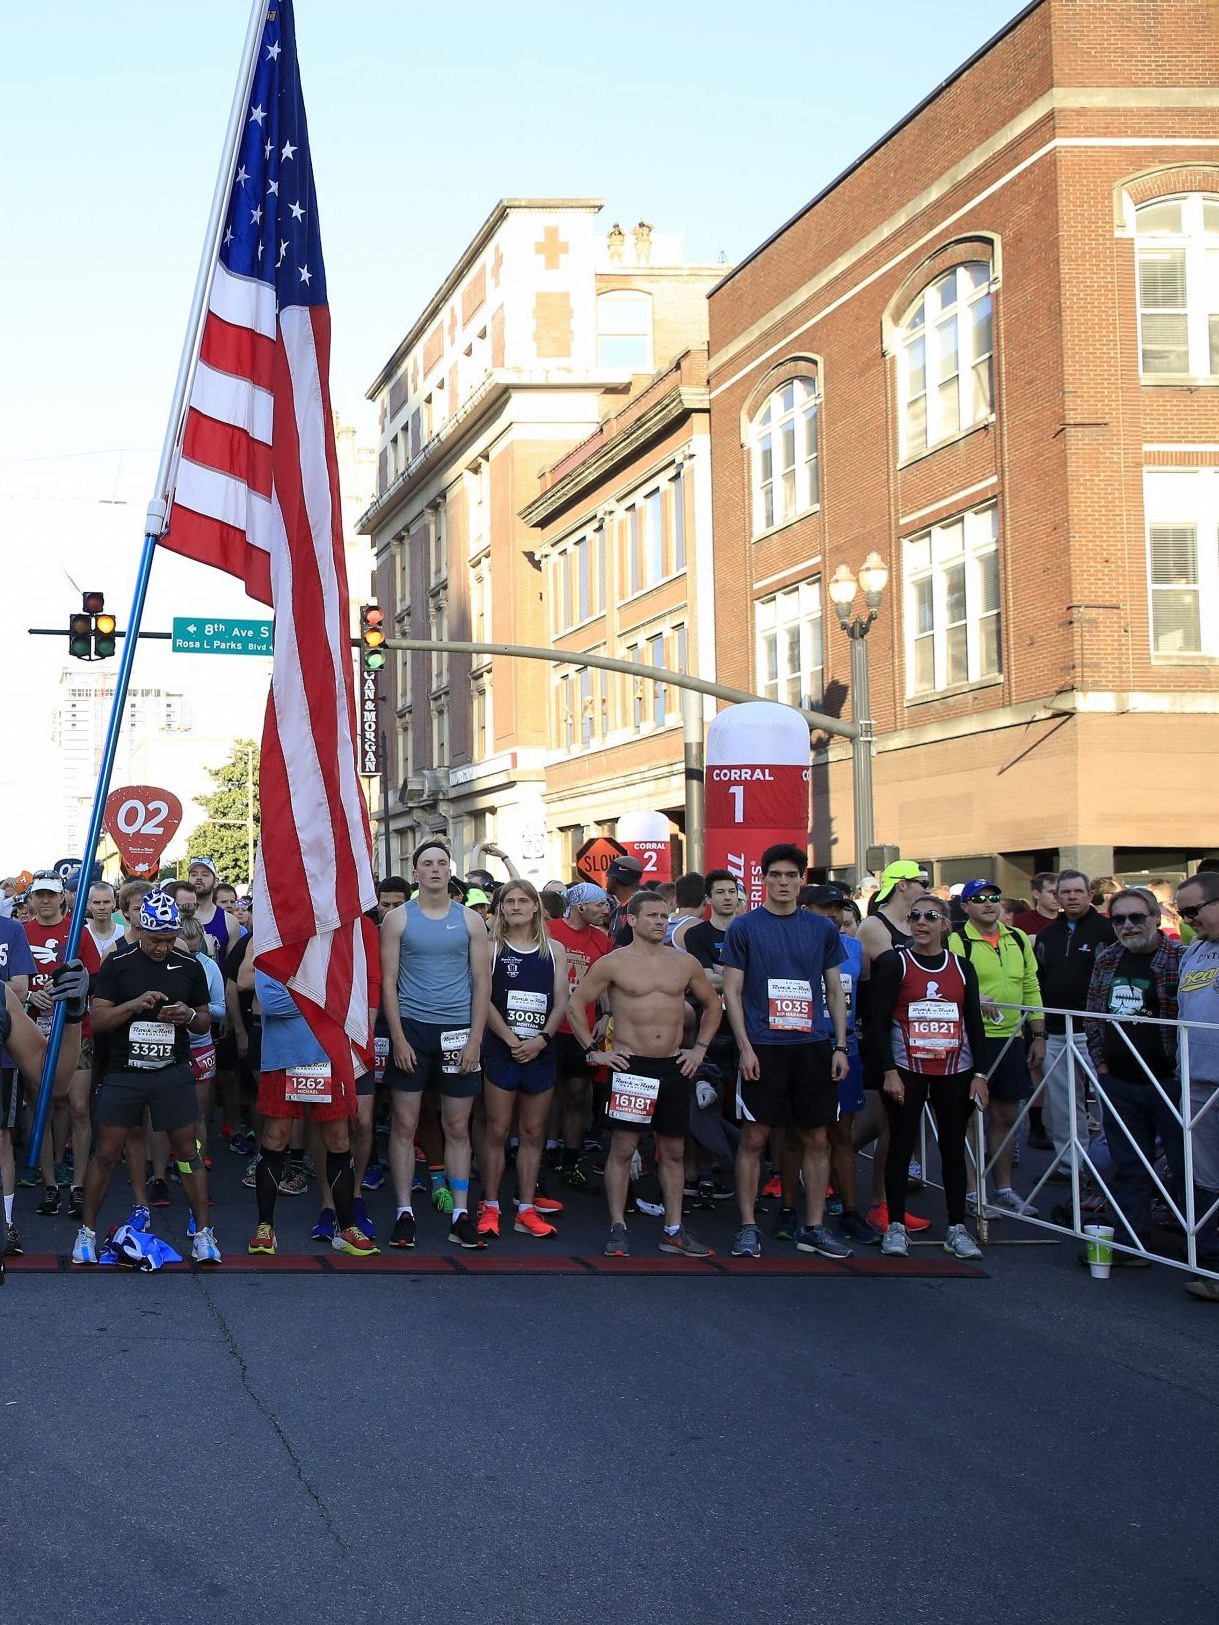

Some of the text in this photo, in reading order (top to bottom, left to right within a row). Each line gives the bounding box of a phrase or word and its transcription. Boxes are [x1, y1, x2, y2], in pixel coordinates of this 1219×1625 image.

[204, 623, 269, 638] 8th Ave S
[176, 639, 266, 651] Rosa L Parks Blvd
[363, 711, 377, 772] MORGAN
[713, 768, 774, 781] CORRAL
[728, 785, 744, 823] 1
[117, 799, 169, 835] 02
[634, 842, 665, 850] CORRAL
[643, 851, 658, 872] 2
[775, 1000, 809, 1013] 1035
[507, 1010, 546, 1025] 30039
[516, 1021, 539, 1029] MONTANA
[912, 1021, 955, 1034] 16821
[131, 1043, 173, 1057] 33213
[291, 1077, 325, 1090] 1262
[614, 1094, 651, 1111] 16181
